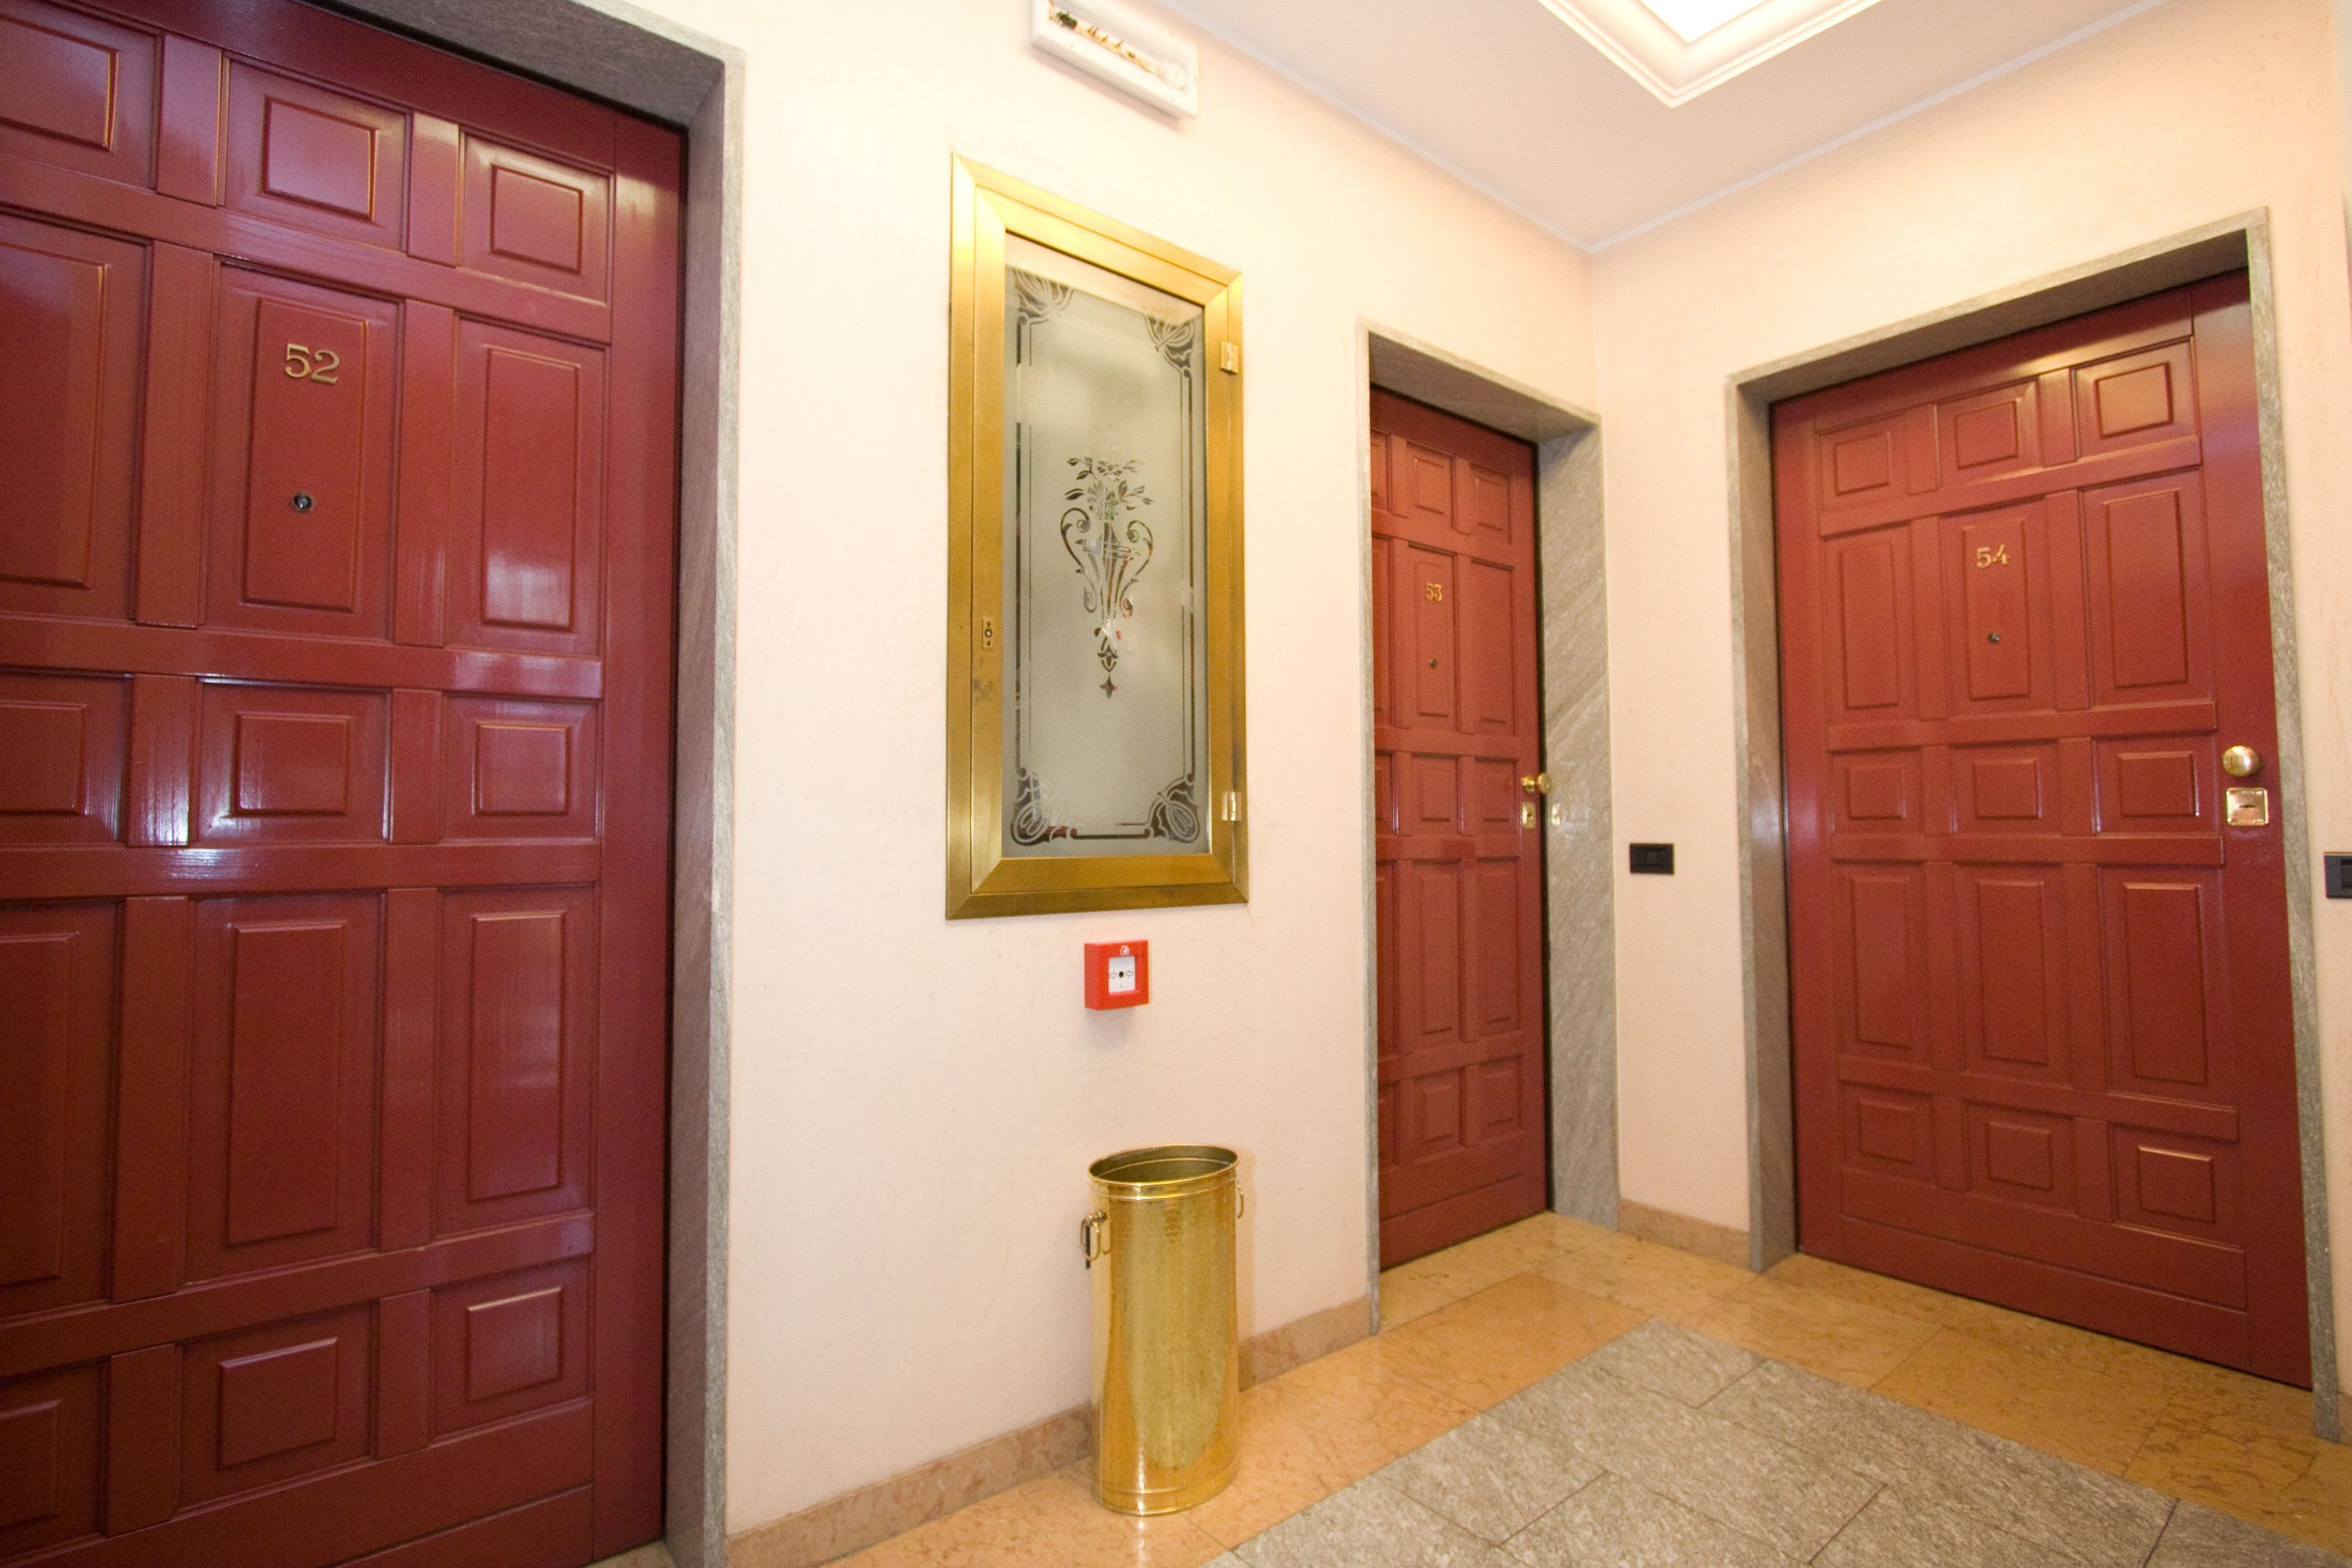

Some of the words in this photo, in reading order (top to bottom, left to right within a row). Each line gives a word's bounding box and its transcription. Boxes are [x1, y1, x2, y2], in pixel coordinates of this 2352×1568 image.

[285, 343, 340, 384] 52
[1976, 544, 2011, 568] 54
[1427, 582, 1442, 601] 53
